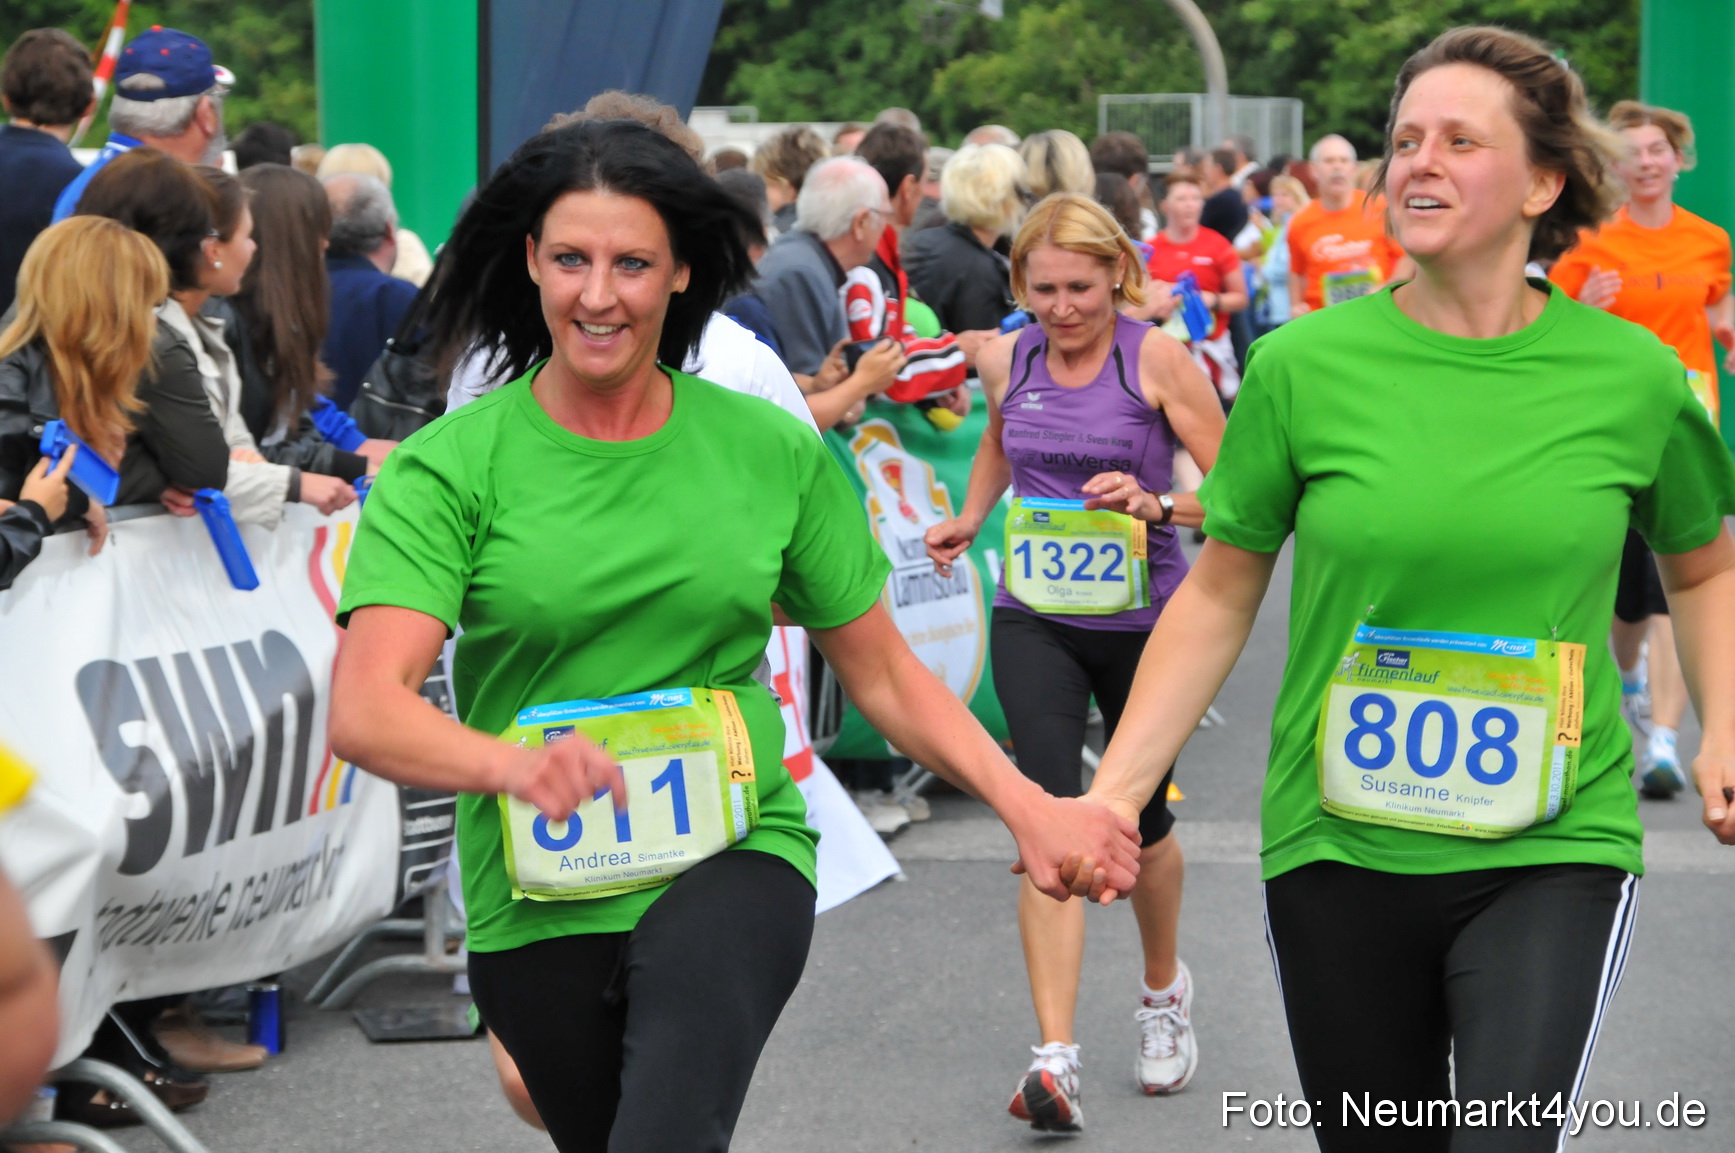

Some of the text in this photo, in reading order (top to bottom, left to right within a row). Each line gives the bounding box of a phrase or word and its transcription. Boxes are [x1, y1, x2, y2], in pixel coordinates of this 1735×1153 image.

[1008, 429, 1040, 439] Manfred
[1042, 430, 1075, 442] Stiegler
[1087, 434, 1109, 446] Sven
[1111, 438, 1133, 449] Krug
[1014, 540, 1126, 582] 1322
[1047, 585, 1073, 597] Olga
[1357, 663, 1440, 684] firmenlauf
[1344, 693, 1519, 785] 808
[1558, 732, 1578, 741] ?
[74, 630, 315, 877] swn
[731, 770, 752, 779] ?
[1550, 762, 1561, 800] 3.10.2011
[1361, 775, 1494, 807] Susanne Knipfer
[1385, 801, 1465, 818] Klinikum Neumarkt
[559, 849, 685, 872] Andrea Simantke
[584, 867, 663, 884] Klinikum Neumarkt
[97, 871, 232, 952] tadtwerke
